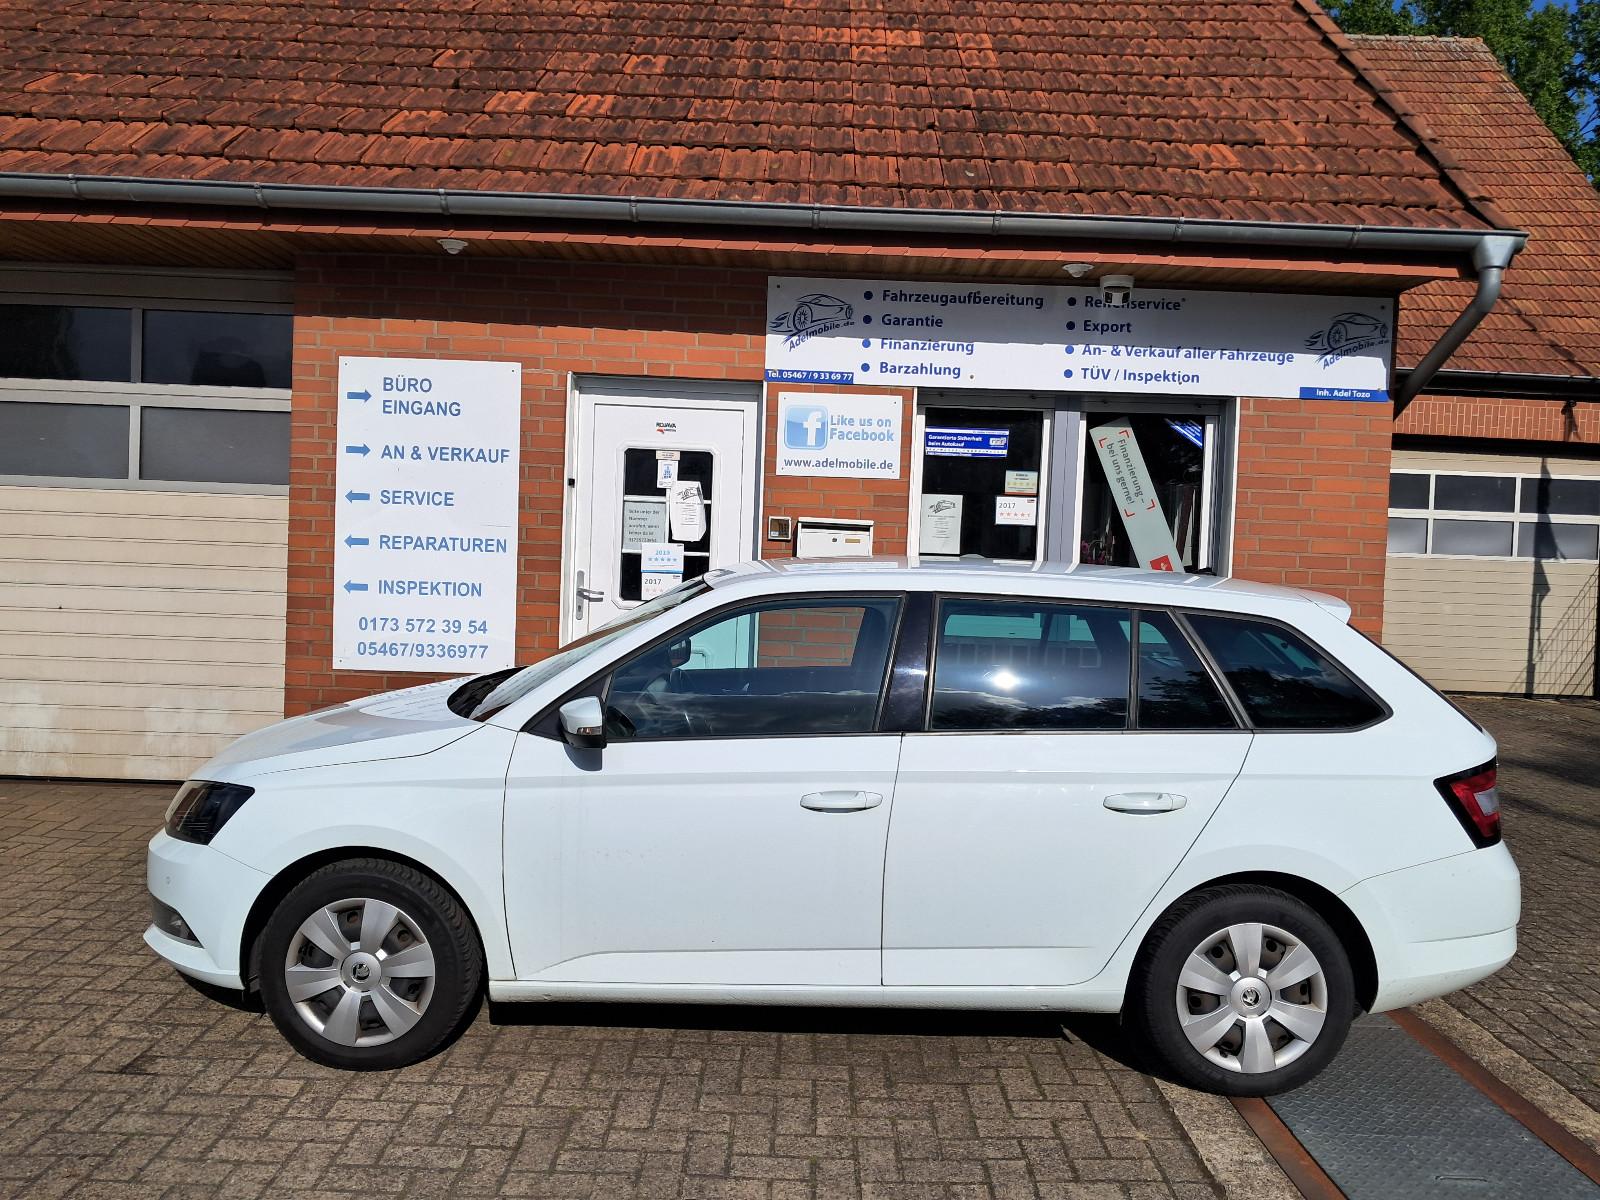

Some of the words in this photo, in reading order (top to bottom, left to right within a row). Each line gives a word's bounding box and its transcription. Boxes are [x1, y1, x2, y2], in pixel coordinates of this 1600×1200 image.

[882, 290, 1044, 310] Fahrzeugaufbereitung
[1085, 295, 1181, 311] Reservice
[882, 314, 944, 328] Garantie
[1083, 320, 1132, 336] Export
[789, 320, 855, 352] Adelmobile.de
[880, 338, 975, 356] Finanzierung
[1082, 344, 1108, 356] An-
[1110, 346, 1122, 357] &
[1124, 346, 1182, 360] Verkauf
[1184, 346, 1216, 360] aller
[1219, 348, 1294, 364] Fahrzeuge
[879, 362, 961, 379] Barzahlung
[1081, 365, 1111, 380] TÜV
[1114, 369, 1120, 382] /
[1123, 370, 1200, 384] Inspektion
[382, 374, 432, 393] BÜRO
[382, 400, 461, 417] EINGANG
[830, 415, 854, 426] Like
[859, 418, 873, 427] us
[877, 419, 891, 428] on
[829, 428, 894, 442] Facebook
[380, 445, 405, 460] AN
[410, 446, 422, 461] &
[428, 446, 510, 464] VERKAUF
[1106, 443, 1116, 458] bei
[784, 458, 893, 470] www.adelmobile.de
[1112, 458, 1122, 475] uns
[1118, 438, 1143, 498] Finanzierung
[380, 490, 455, 507] SERVICE
[1116, 477, 1135, 505] gerne!
[379, 534, 507, 554] REPARATUREN
[378, 580, 482, 597] INSPEKTION
[358, 616, 399, 632] 0173
[405, 618, 436, 633] 572
[441, 618, 462, 634] 39
[468, 620, 488, 635] 54
[357, 641, 489, 659] 05467/9336977
